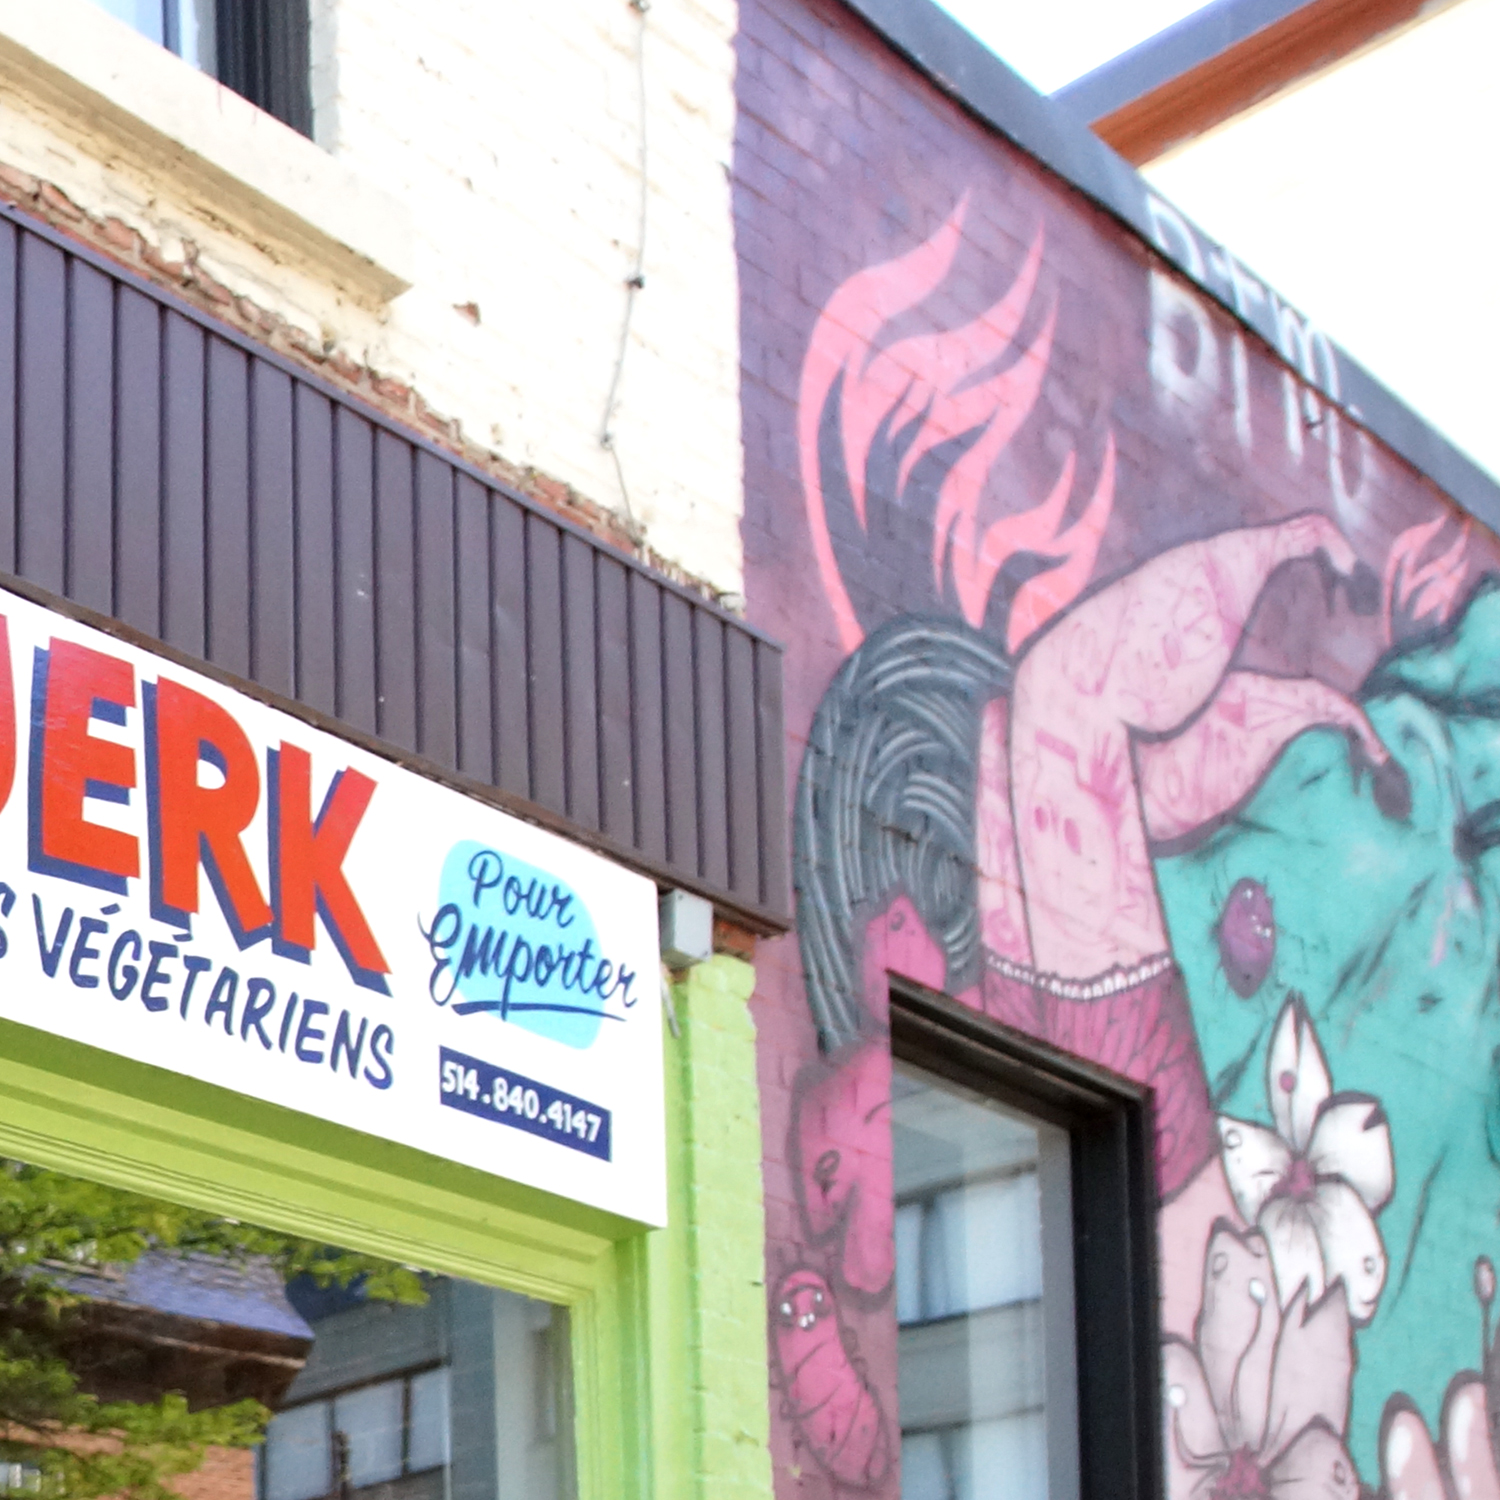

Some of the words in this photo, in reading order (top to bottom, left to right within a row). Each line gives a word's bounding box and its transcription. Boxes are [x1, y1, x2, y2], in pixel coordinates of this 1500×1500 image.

[467, 849, 576, 929] Pour
[31, 894, 396, 1090] VÉGÉTARIENS
[417, 901, 638, 1021] Emporter
[440, 1060, 603, 1145] 514.840.4147
